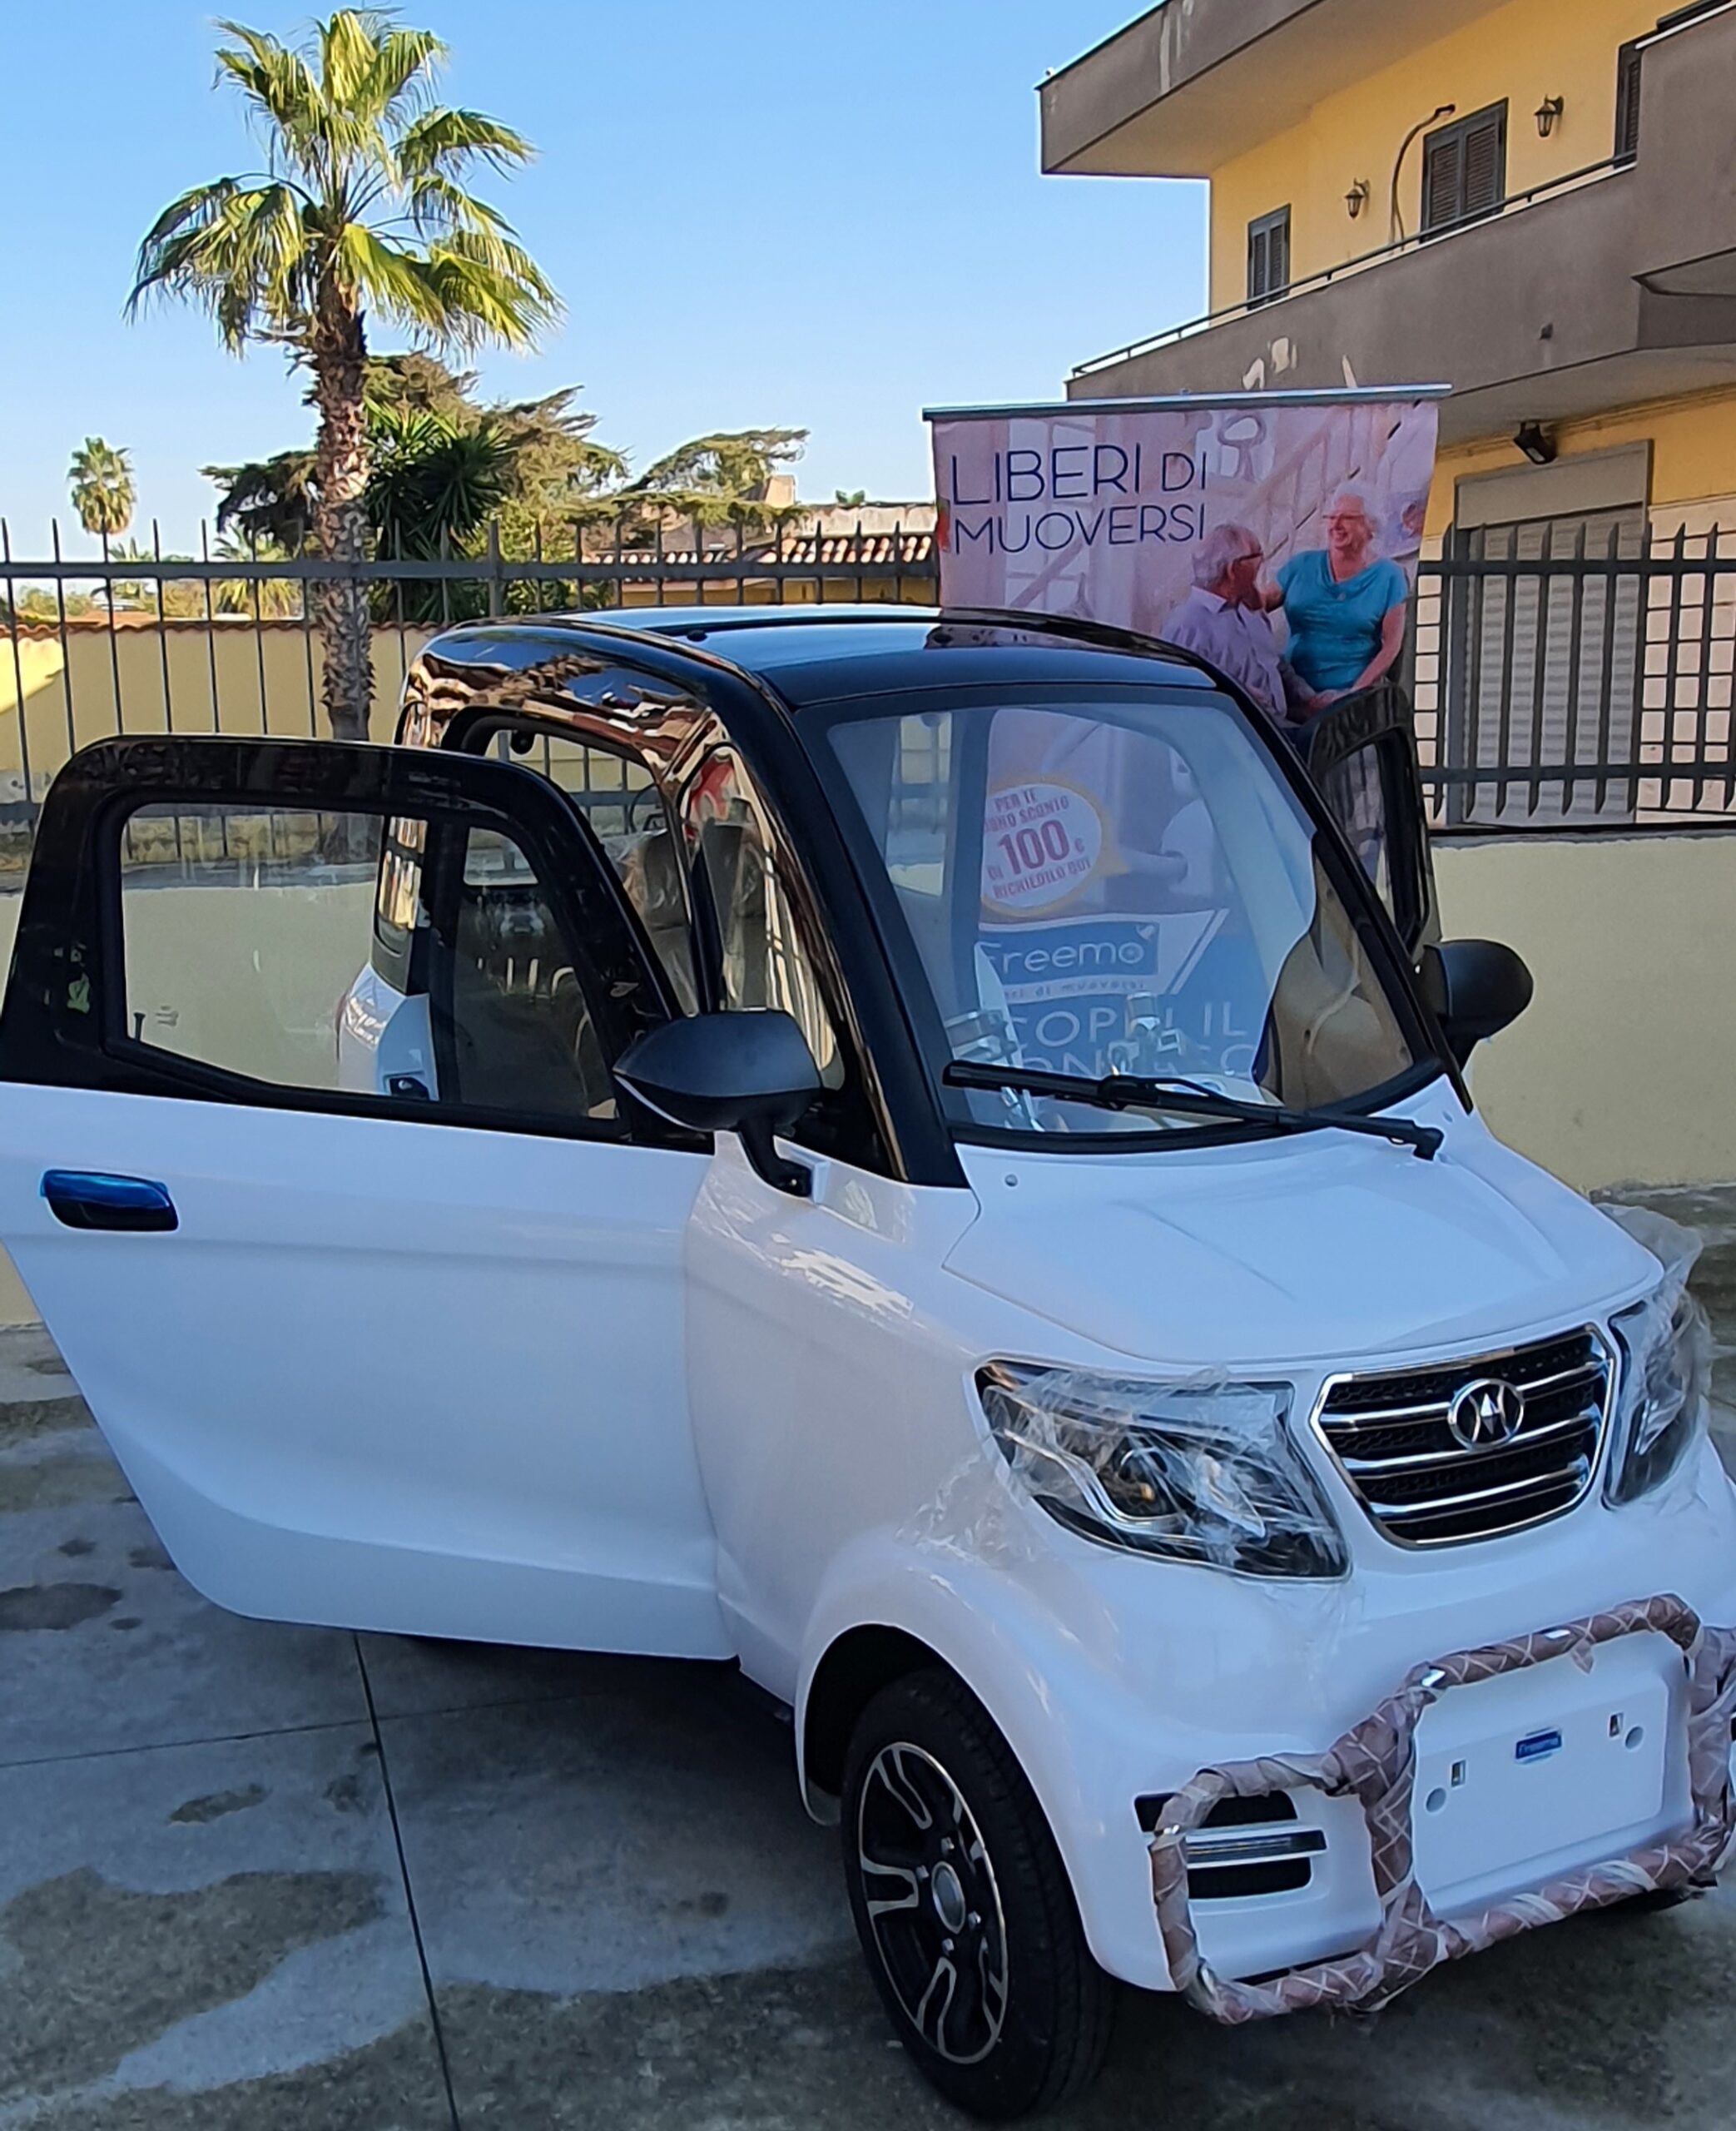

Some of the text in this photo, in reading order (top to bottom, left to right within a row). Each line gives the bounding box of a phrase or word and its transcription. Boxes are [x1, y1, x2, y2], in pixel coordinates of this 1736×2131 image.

[952, 443, 1206, 504] LIBERI DI
[955, 503, 1204, 555] MUOVERSI
[994, 793, 1020, 812] PER
[1019, 796, 1069, 823] SCONTO
[999, 819, 1069, 876] 100
[993, 865, 1066, 900] RICHIEDILO
[1203, 1001, 1247, 1036] IL
